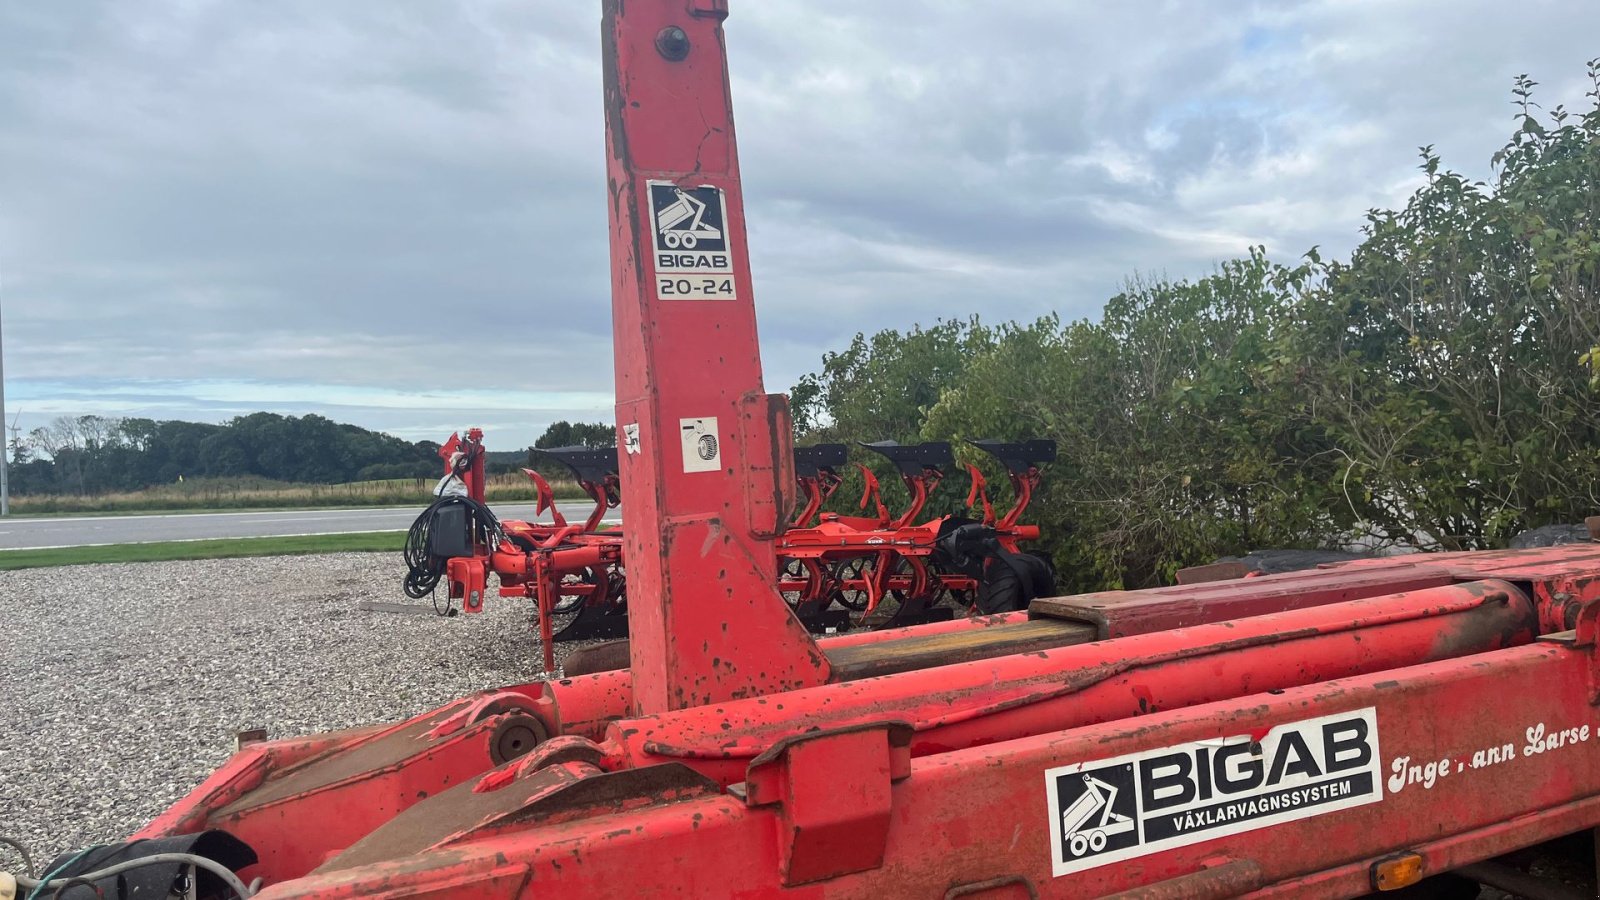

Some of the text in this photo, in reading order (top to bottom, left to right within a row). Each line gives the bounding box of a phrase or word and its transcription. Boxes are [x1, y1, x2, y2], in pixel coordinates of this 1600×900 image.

[658, 254, 728, 268] BIGAB
[660, 279, 733, 294] 20-24
[1139, 717, 1373, 813] BIGAB
[1388, 722, 1600, 794] Ingeann Larse
[1173, 780, 1352, 832] VÄXLARVAGNSSYSTEM
